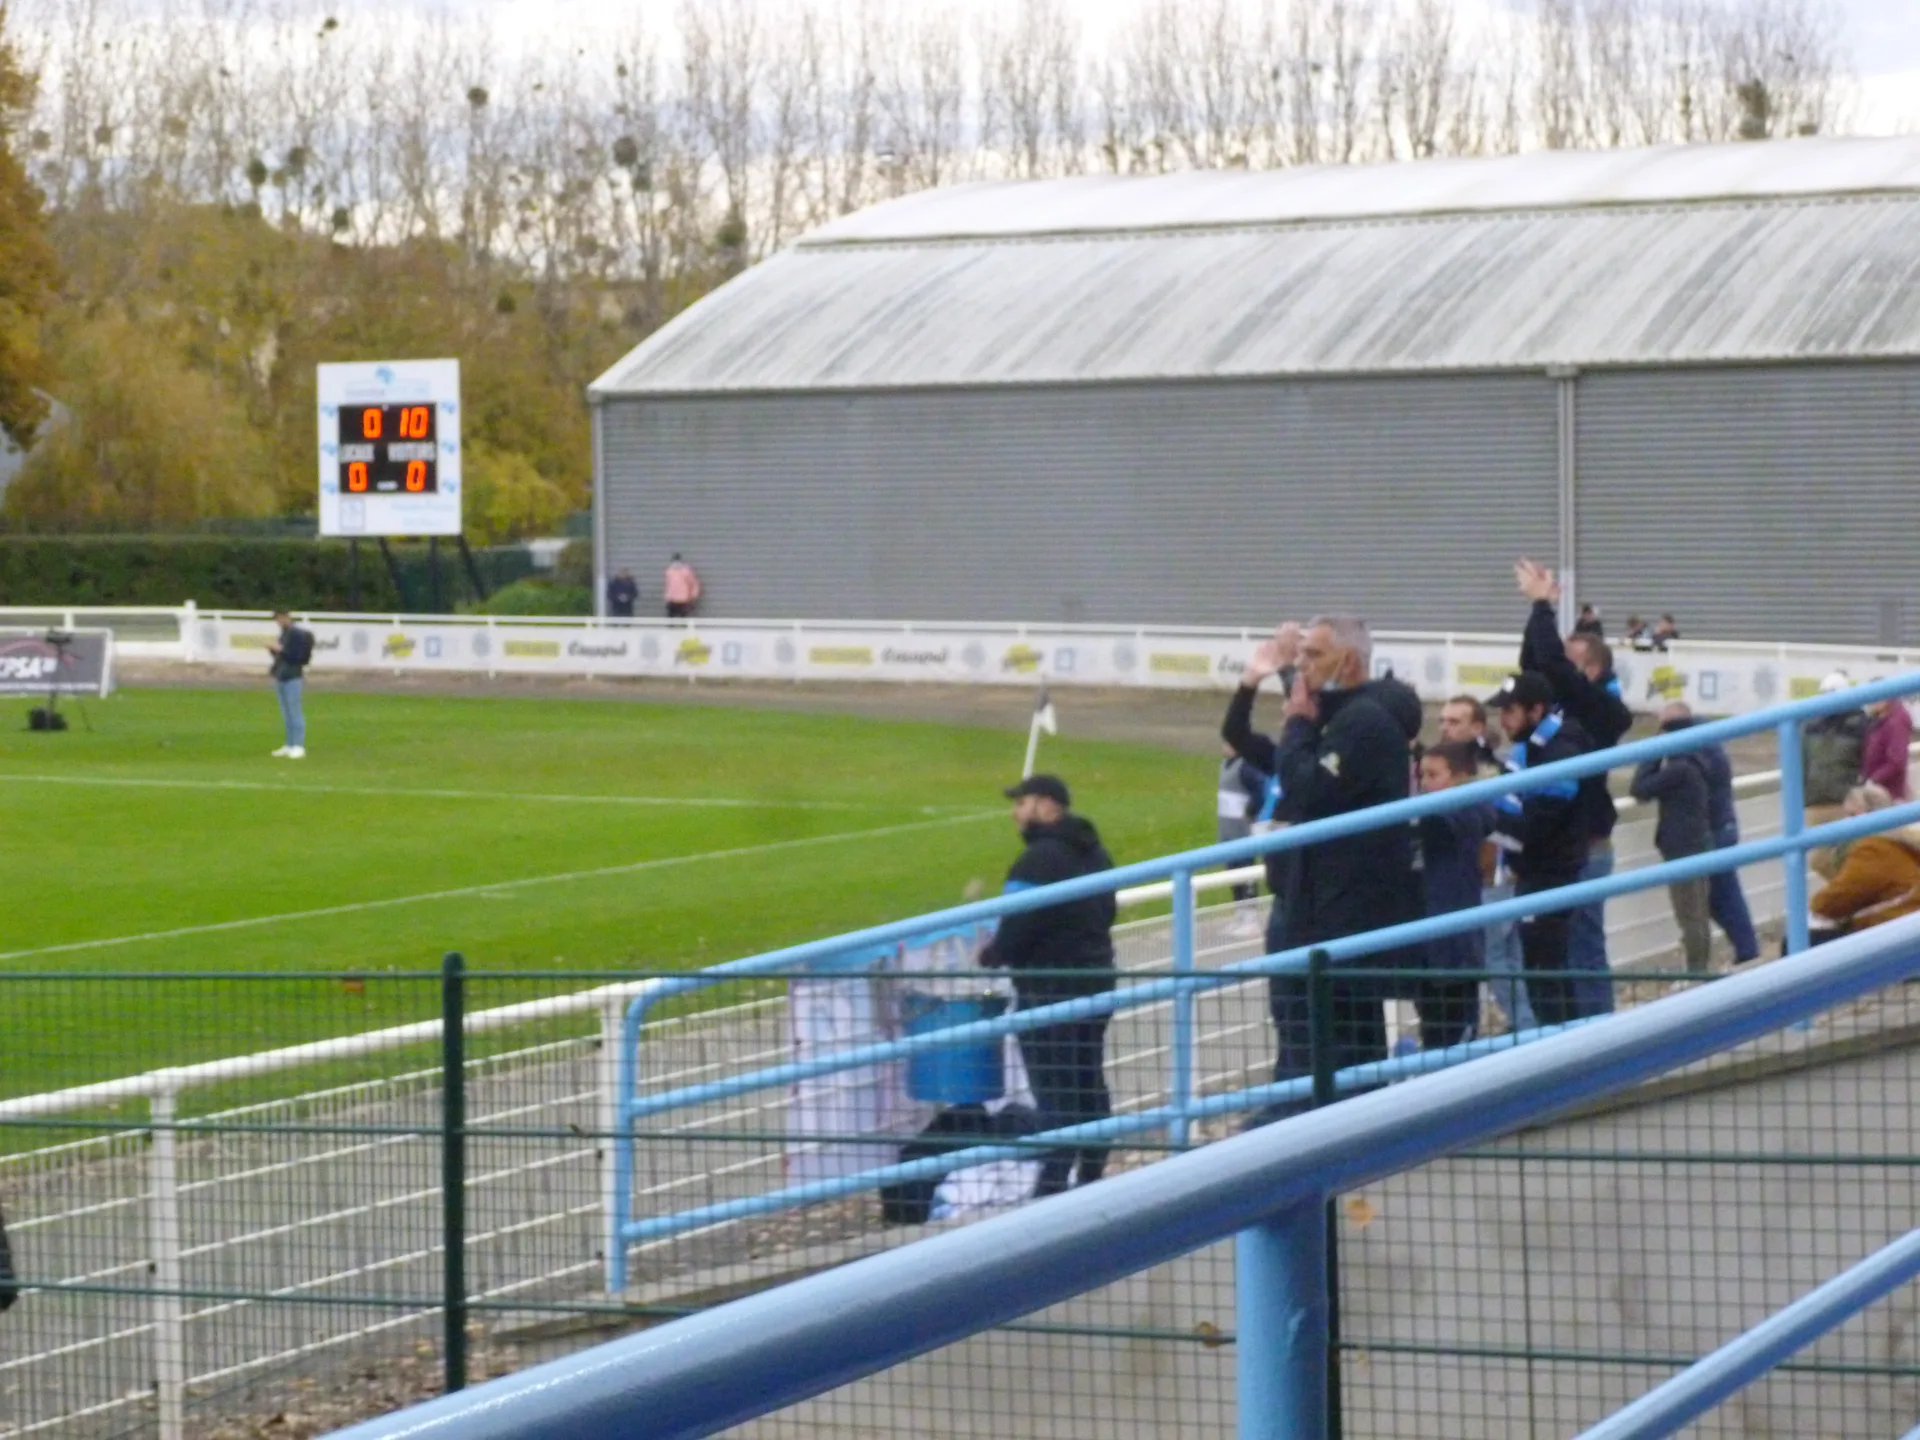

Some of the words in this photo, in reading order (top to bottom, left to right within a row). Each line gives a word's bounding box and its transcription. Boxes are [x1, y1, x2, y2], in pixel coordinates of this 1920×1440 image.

[363, 408, 382, 439] 0
[400, 406, 429, 438] 10
[349, 461, 368, 492] 0
[406, 460, 427, 492] 0
